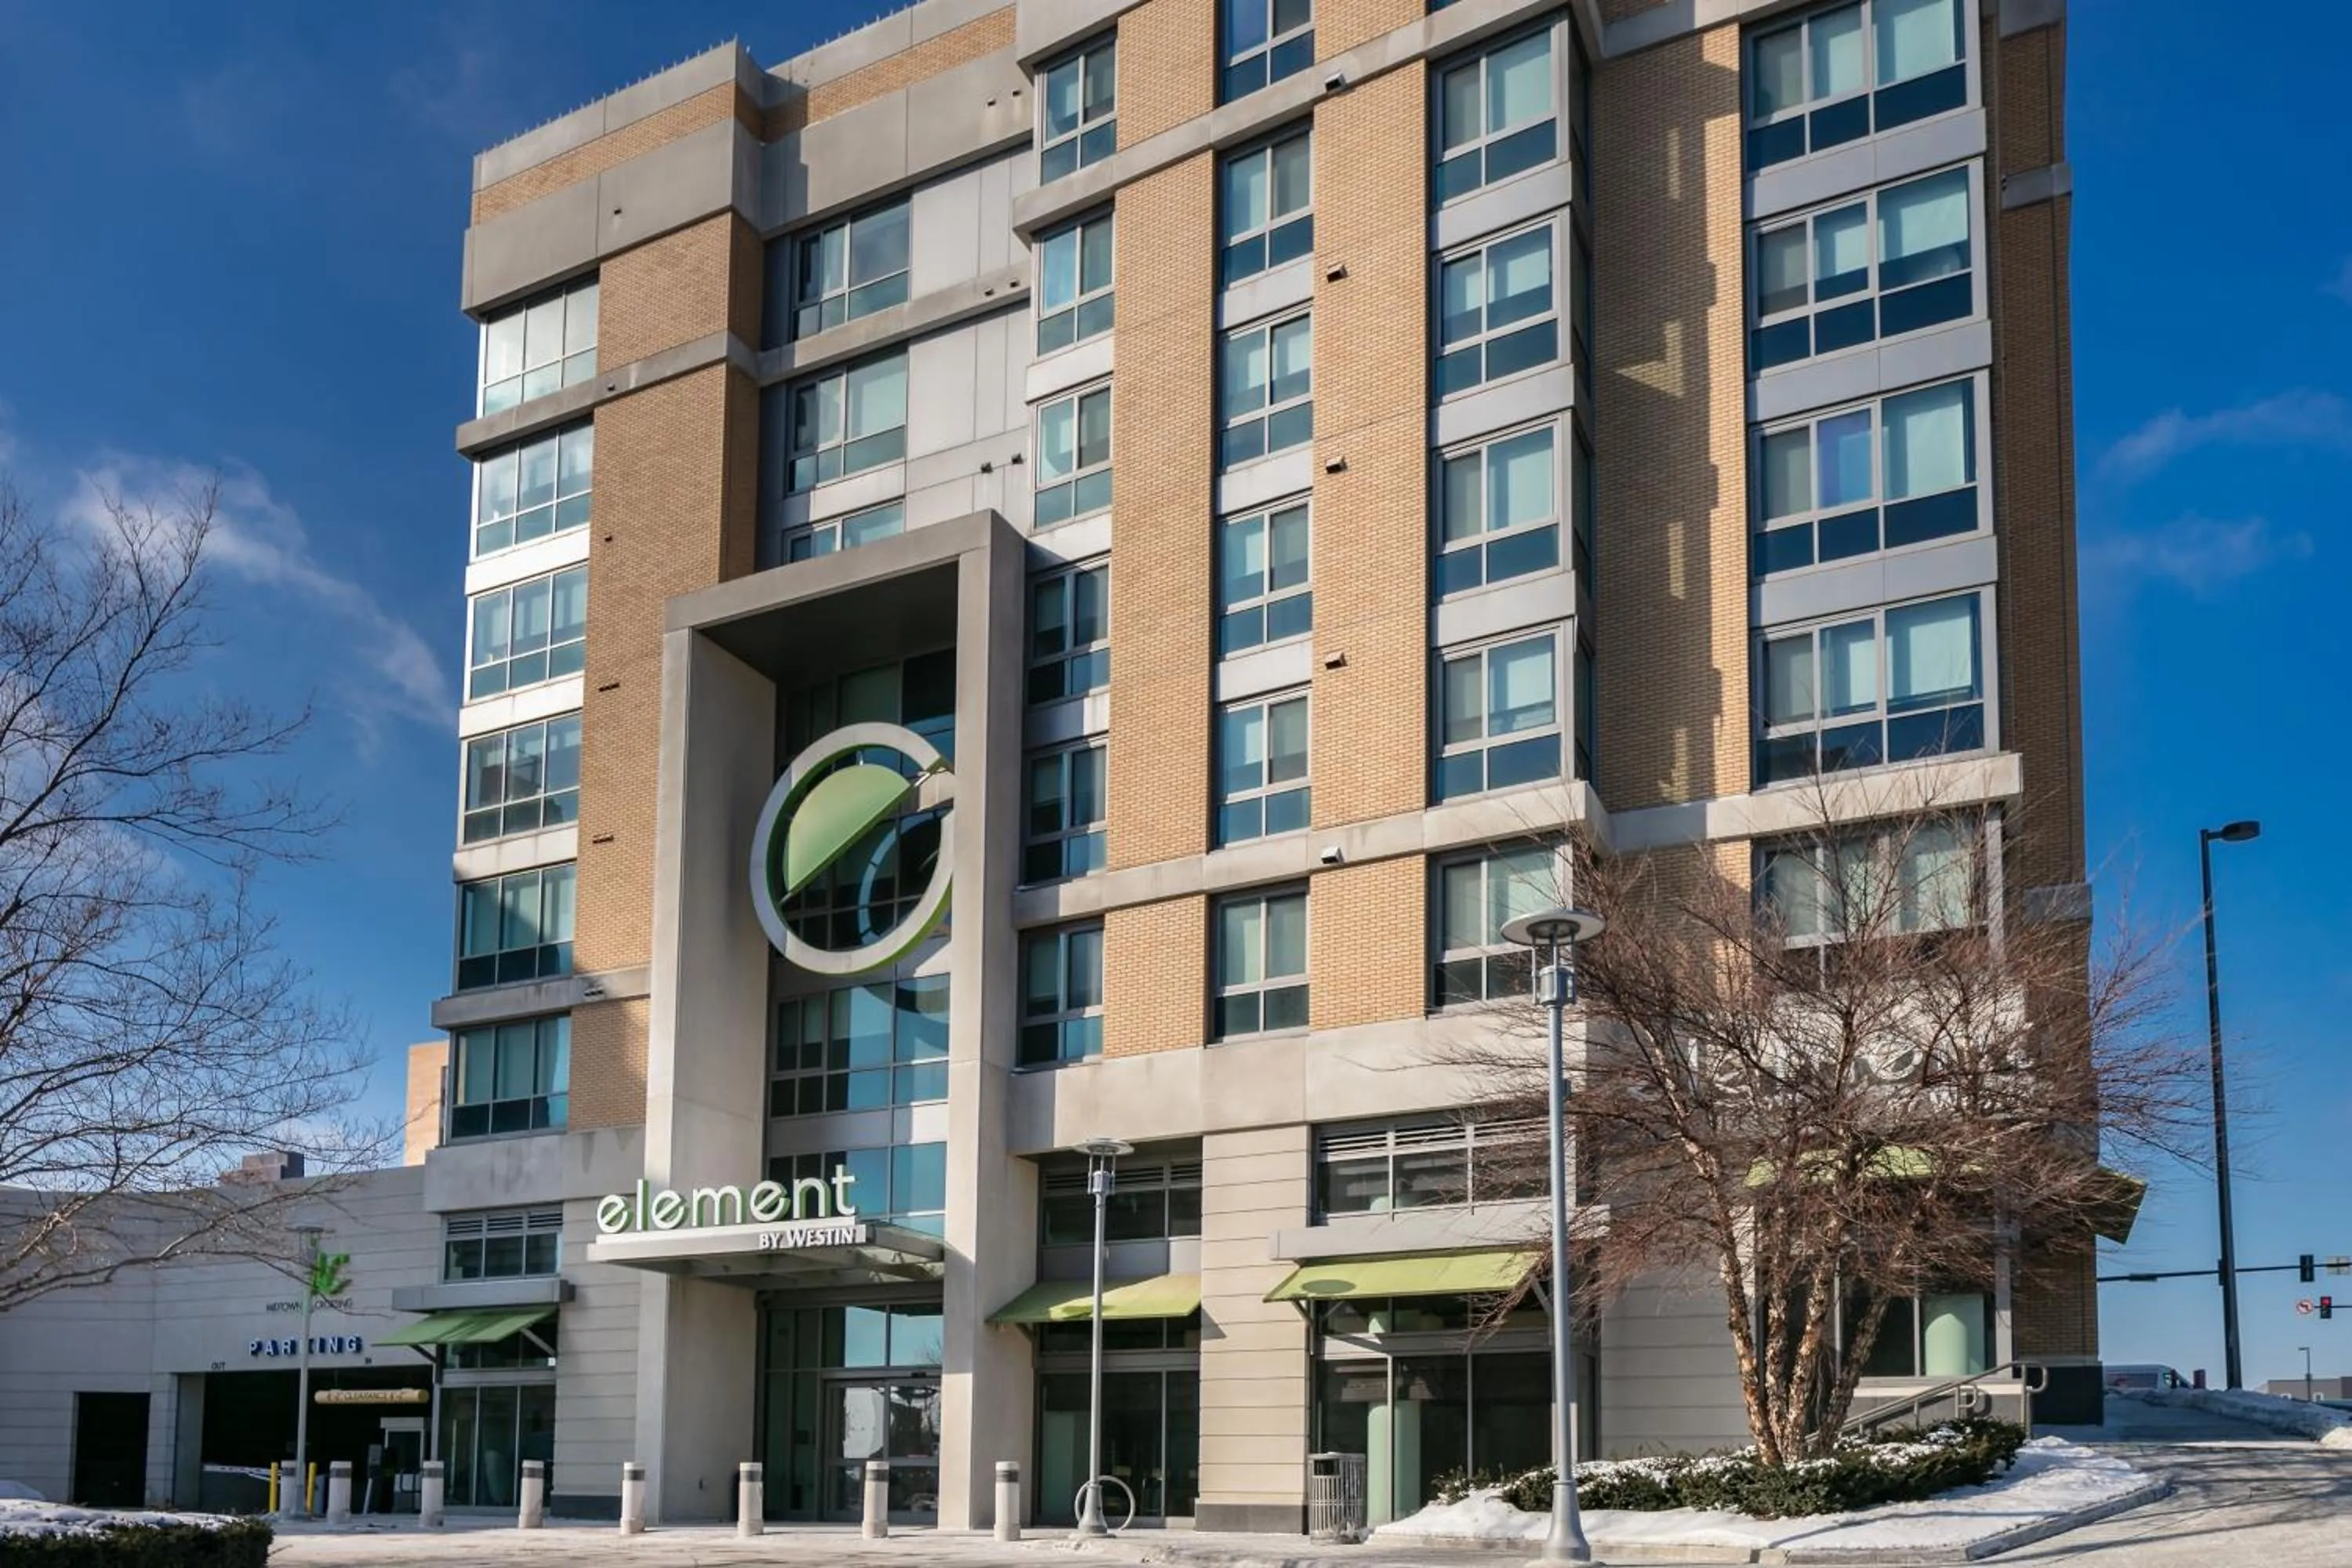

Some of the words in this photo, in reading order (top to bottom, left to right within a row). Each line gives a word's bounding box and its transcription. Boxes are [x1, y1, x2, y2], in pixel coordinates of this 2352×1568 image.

[597, 1164, 857, 1233] element
[759, 1232, 780, 1250] BY
[786, 1227, 855, 1248] WESTIN
[249, 1335, 361, 1356] PARING
